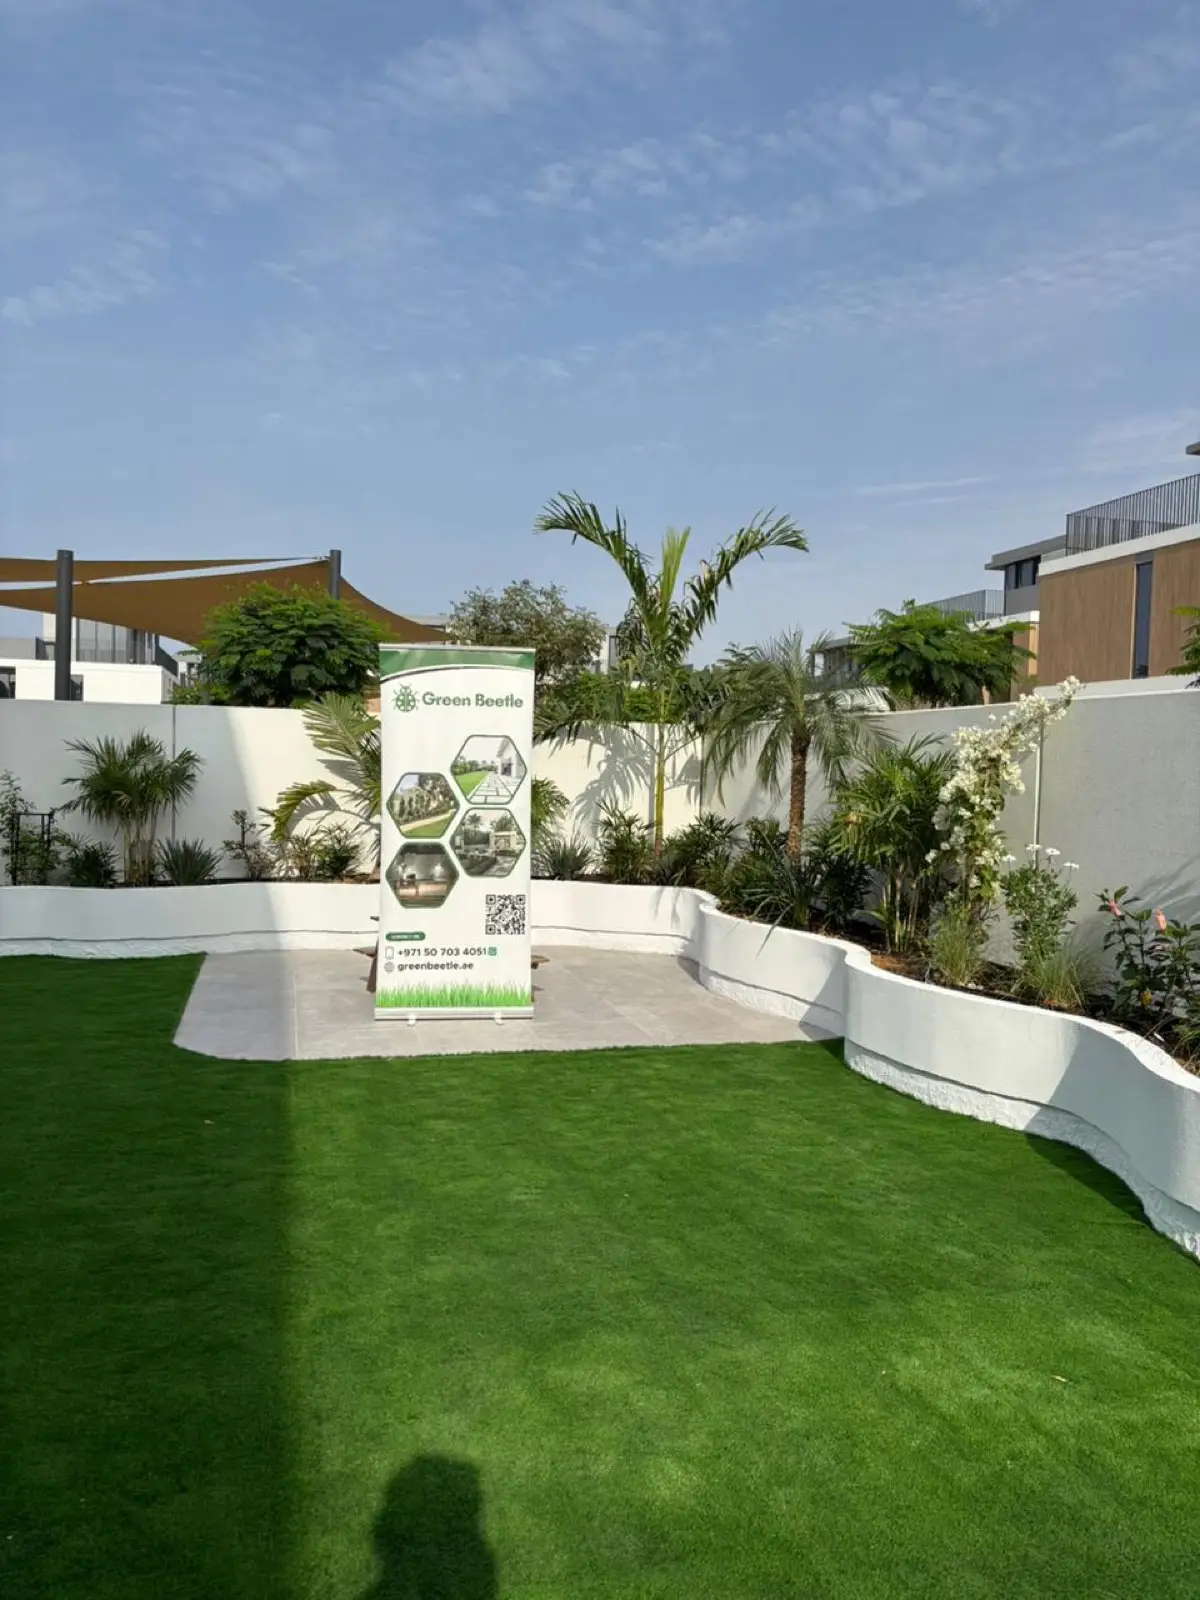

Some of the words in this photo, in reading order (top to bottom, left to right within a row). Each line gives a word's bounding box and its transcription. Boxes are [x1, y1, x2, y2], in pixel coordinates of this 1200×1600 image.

[422, 691, 471, 706] Green
[475, 692, 524, 708] Beetle
[398, 948, 421, 957] +971
[423, 948, 438, 957] 50
[440, 947, 460, 957] 703
[462, 947, 487, 957] 4051
[397, 961, 474, 972] greenbeetle.ae
